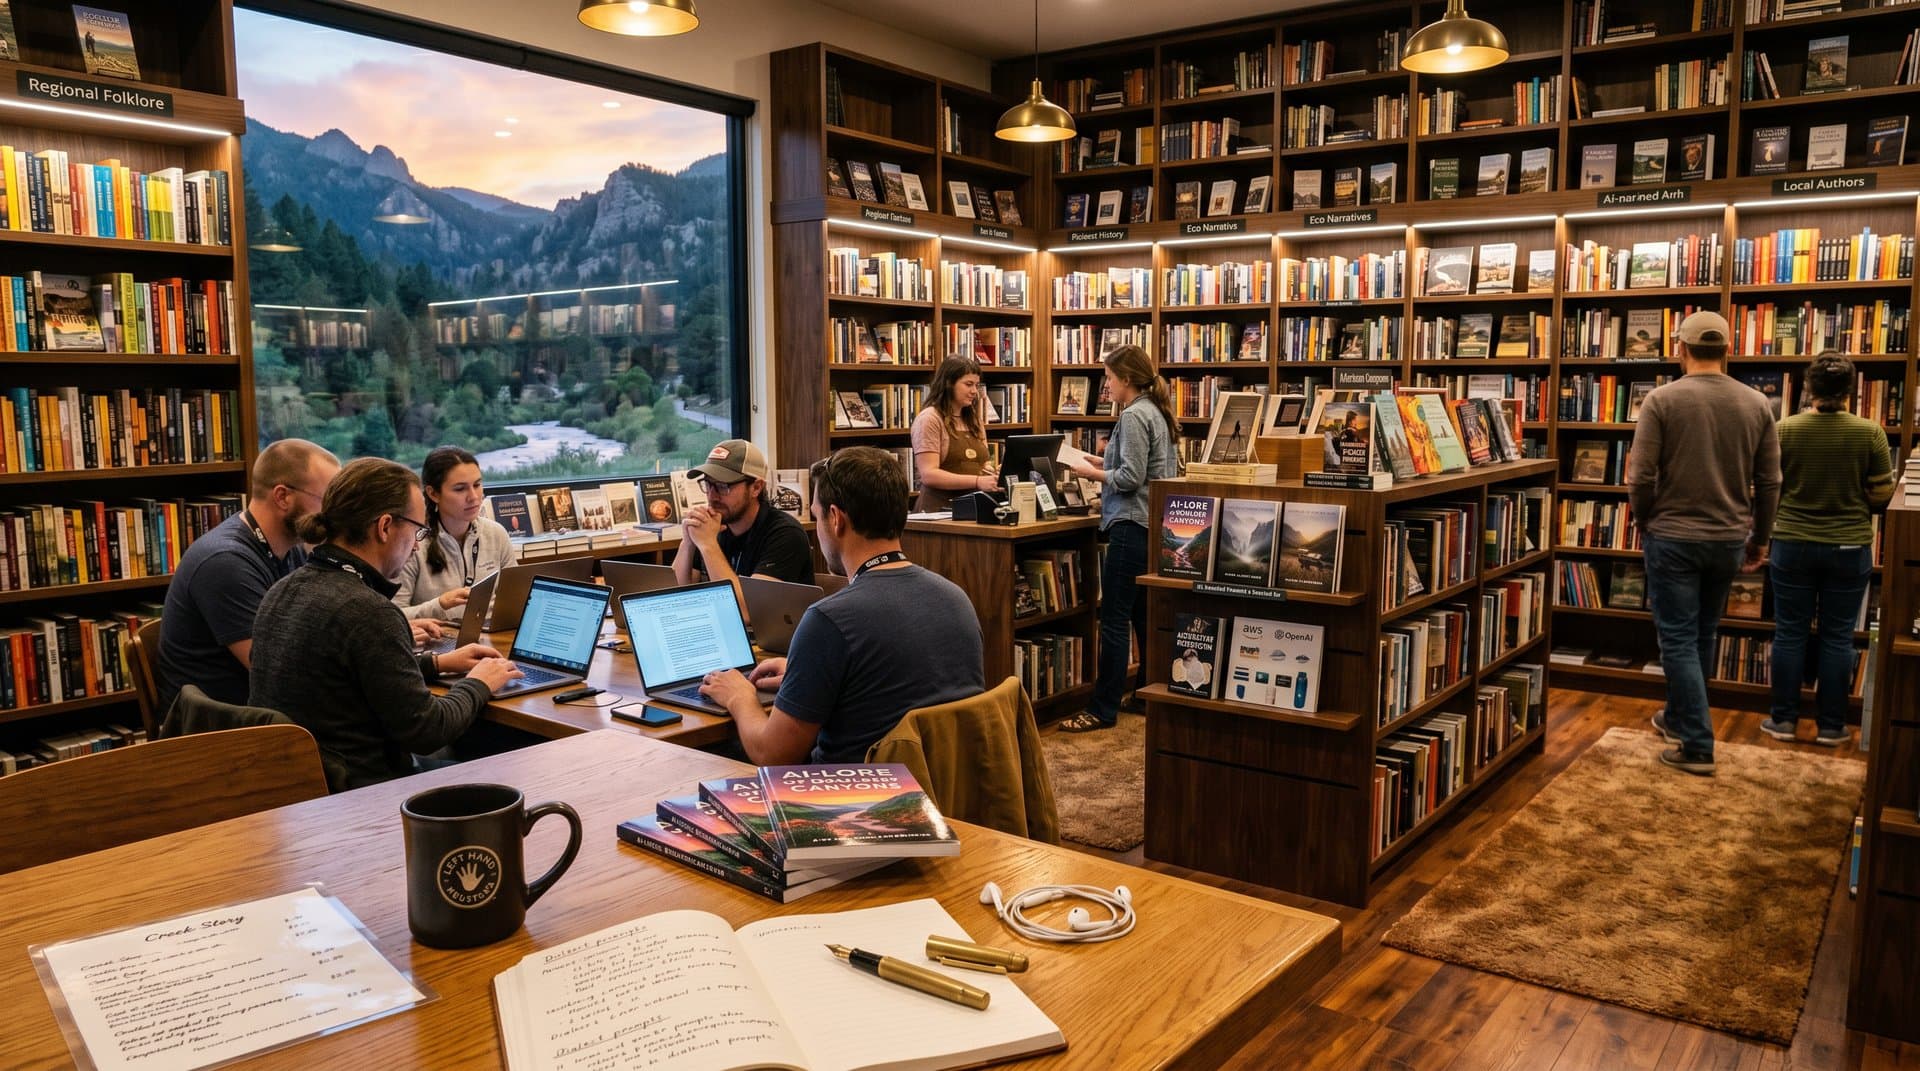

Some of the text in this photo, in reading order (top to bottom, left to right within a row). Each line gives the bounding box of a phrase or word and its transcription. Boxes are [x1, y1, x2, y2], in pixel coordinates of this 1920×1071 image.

[28, 77, 165, 110] Regional Folklore
[1783, 177, 1865, 192] Local Authors
[1309, 212, 1372, 225] Eco Narratives
[1186, 224, 1202, 233] Eco
[1099, 231, 1125, 240] History
[1169, 500, 1208, 511] AI-LORE
[1169, 516, 1205, 527] CANYONS
[1242, 624, 1263, 635] aws
[1284, 632, 1314, 642] OpenAI
[782, 768, 894, 780] AI-LORE
[790, 782, 902, 793] CANYONS
[443, 851, 496, 876] LEFT HAND
